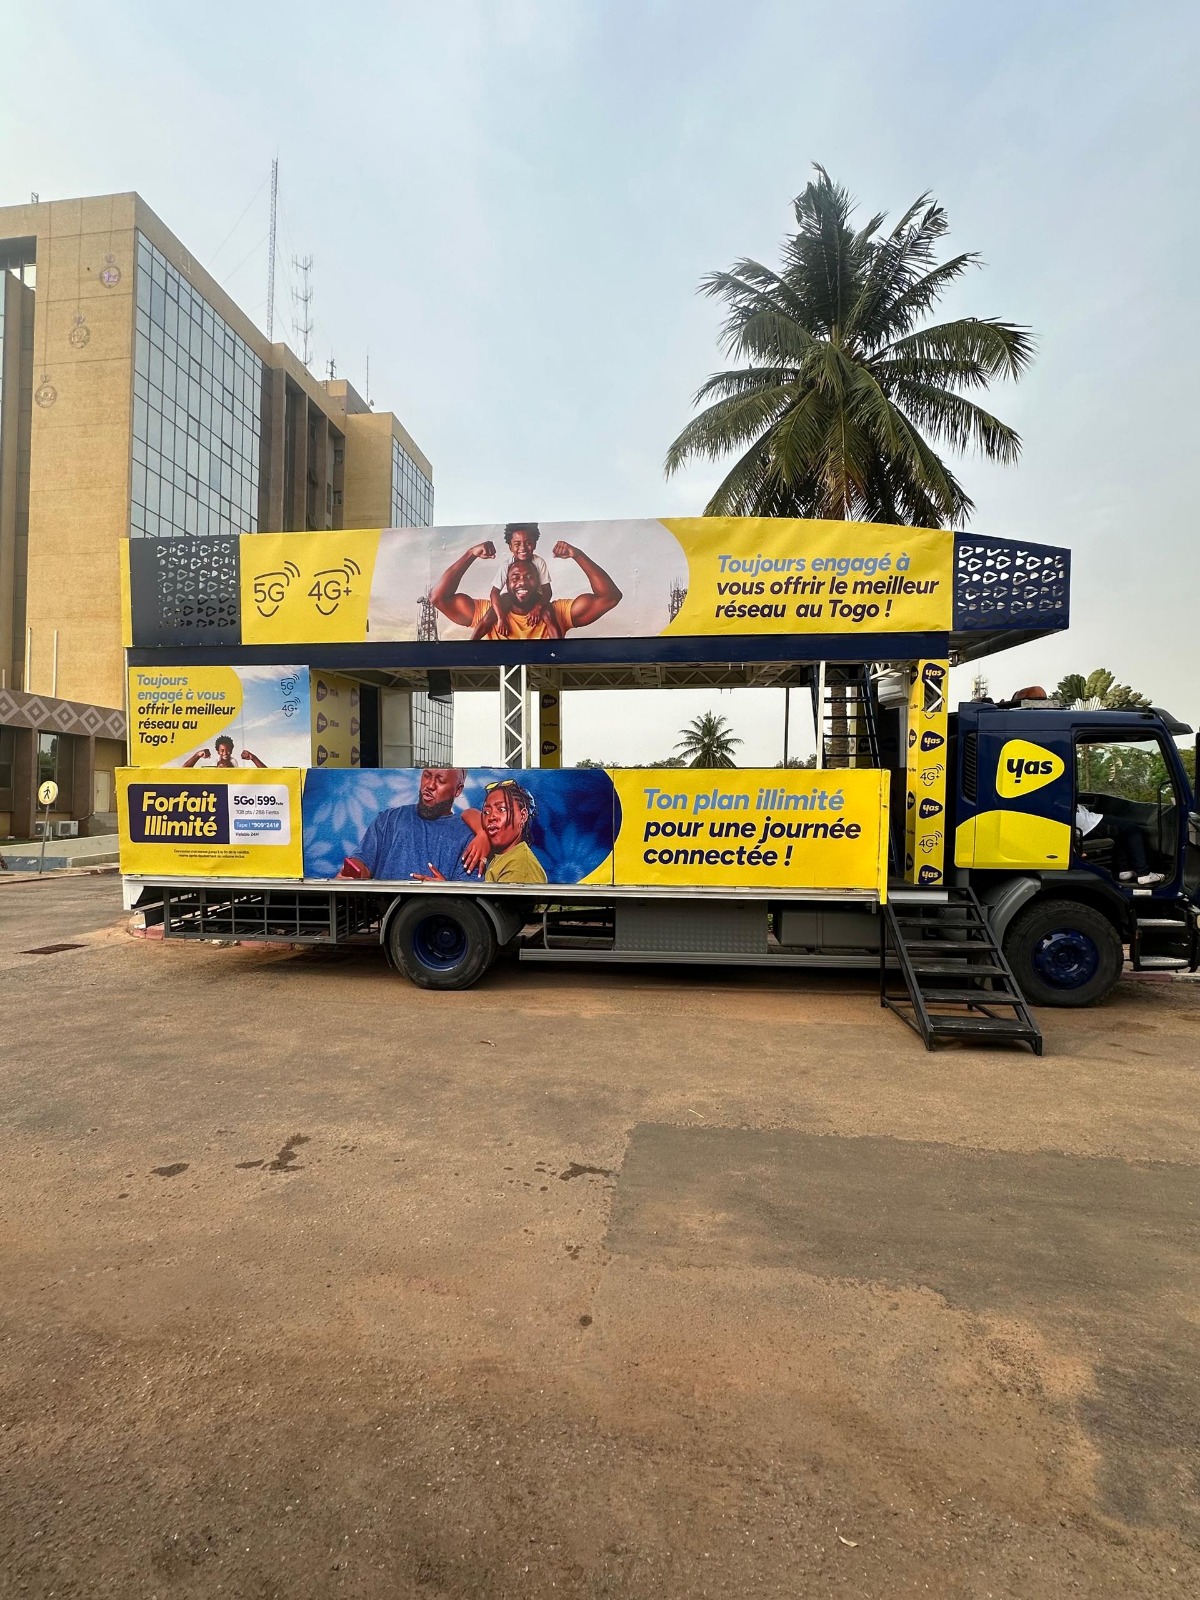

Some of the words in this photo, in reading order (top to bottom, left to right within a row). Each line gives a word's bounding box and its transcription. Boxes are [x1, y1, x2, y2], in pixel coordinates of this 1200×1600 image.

[717, 553, 806, 577] Toujours
[811, 552, 891, 576] engagé
[895, 552, 911, 572] à
[253, 582, 285, 603] 5G
[307, 579, 352, 601] 4G+
[716, 579, 765, 595] vous
[769, 576, 826, 595] offrir
[828, 576, 848, 595] le
[852, 575, 940, 595] meilleur
[715, 600, 787, 618] réseau
[795, 603, 823, 618] au
[828, 599, 880, 622] Togo
[884, 599, 893, 618] !
[137, 673, 188, 689] Toujours
[280, 681, 294, 691] 5G
[137, 688, 183, 703] engagé
[185, 688, 194, 700] à
[196, 690, 226, 700] vous
[137, 702, 170, 715] offrir
[171, 703, 183, 715] le
[185, 703, 236, 715] meilleur
[138, 717, 179, 730] réseau
[182, 719, 198, 730] au
[138, 732, 168, 746] Togo
[919, 771, 940, 781] 4G+
[1006, 758, 1053, 784] yas
[142, 790, 218, 813] Forfait
[643, 788, 688, 810] Ton
[692, 788, 750, 815] plan
[755, 787, 845, 811] illimité
[144, 815, 218, 837] Illimité
[643, 820, 704, 842] pour
[708, 822, 757, 839] une
[757, 815, 862, 844] journée
[918, 838, 939, 848] 4G+
[643, 844, 778, 867] connectée
[783, 845, 794, 867] !
